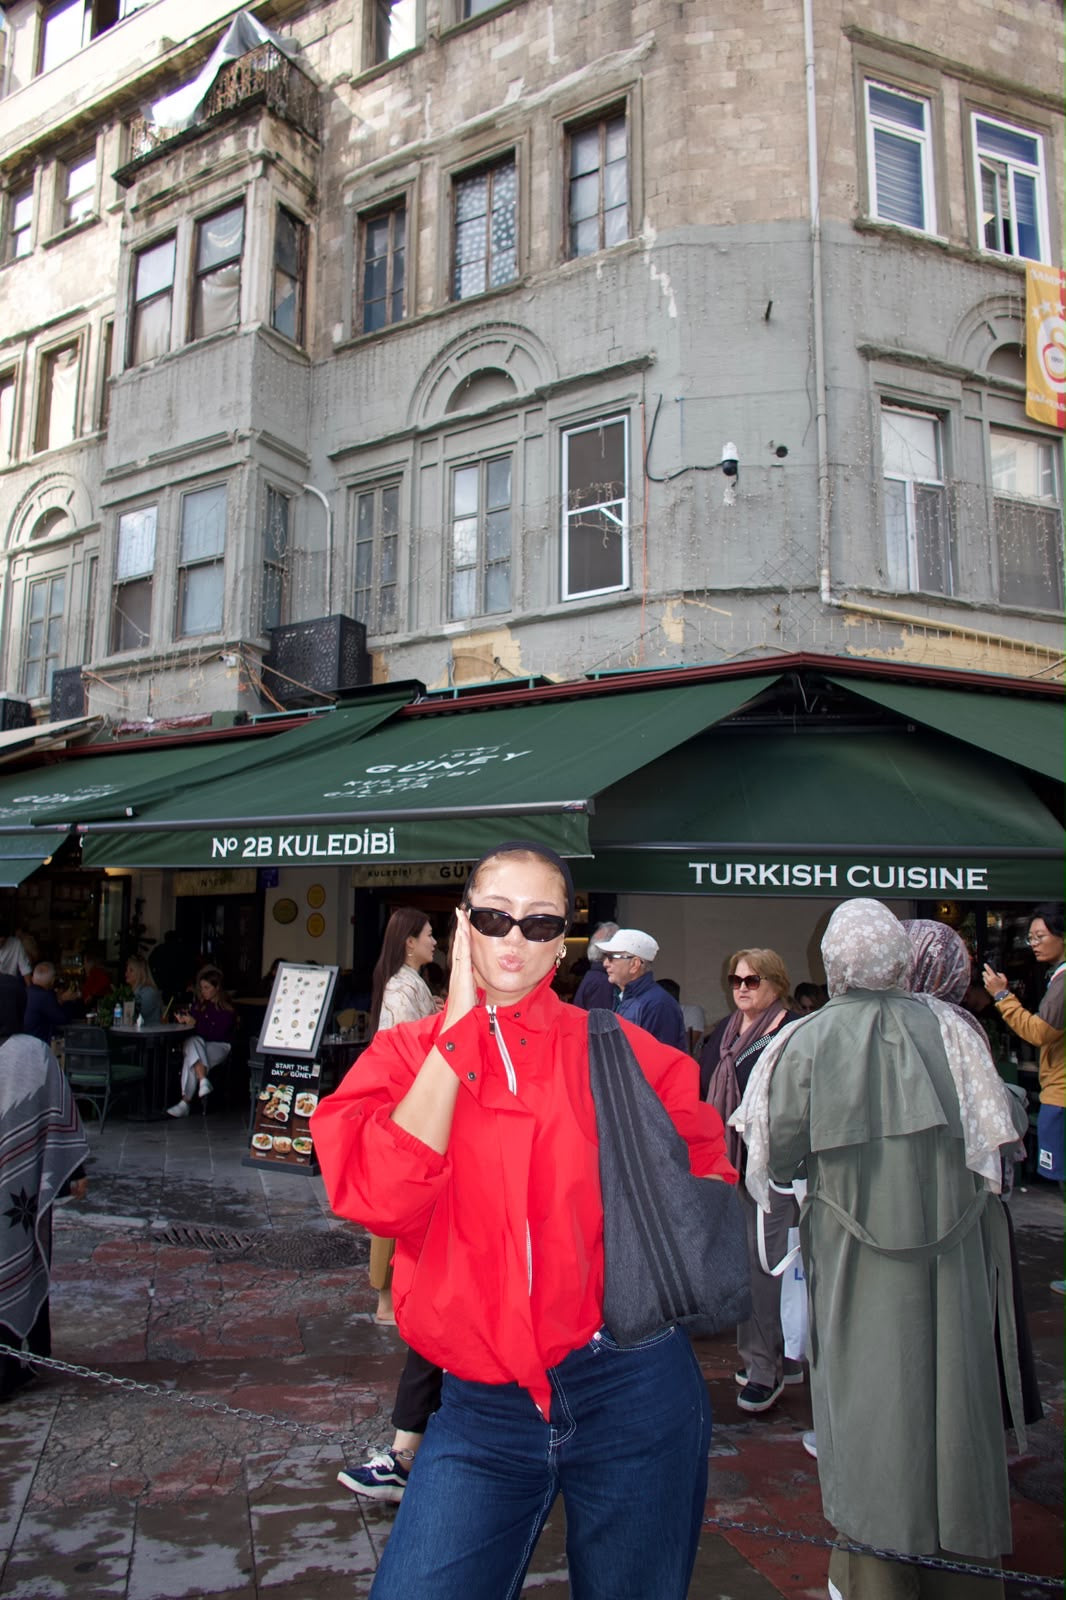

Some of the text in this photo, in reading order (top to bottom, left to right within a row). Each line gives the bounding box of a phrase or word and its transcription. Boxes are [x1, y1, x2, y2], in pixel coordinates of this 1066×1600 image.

[366, 750, 533, 774] GÜNEY
[242, 836, 273, 858] 2B
[278, 827, 395, 856] KULEDİBİ
[688, 862, 988, 891] TURKISH CUISINE
[275, 1062, 310, 1072] START THE
